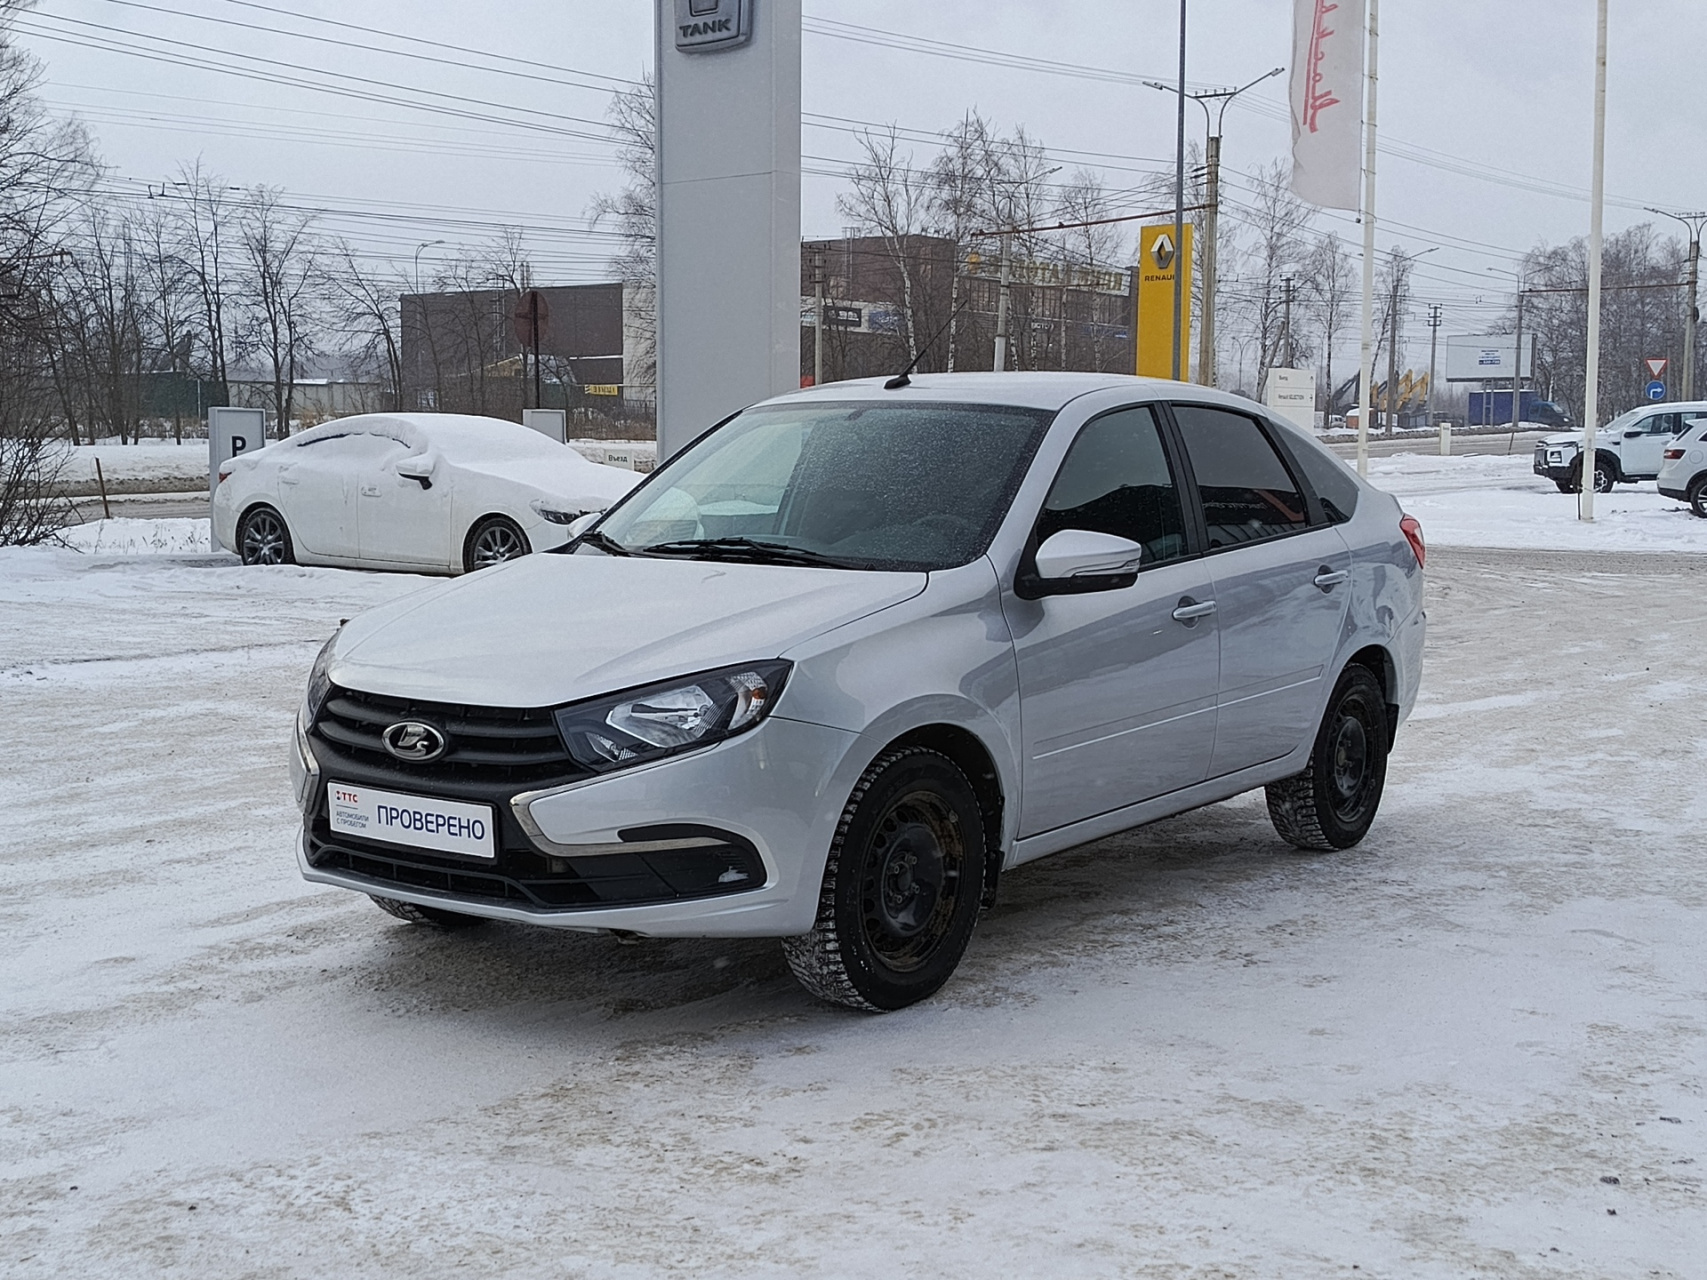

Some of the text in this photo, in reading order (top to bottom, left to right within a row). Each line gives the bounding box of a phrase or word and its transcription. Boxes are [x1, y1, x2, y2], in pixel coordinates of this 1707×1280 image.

[679, 18, 731, 38] TANK
[1144, 274, 1175, 282] RENAU
[231, 435, 247, 458] P
[341, 791, 358, 803] ТТС
[377, 805, 485, 840] ПРОВЕРЕНО
